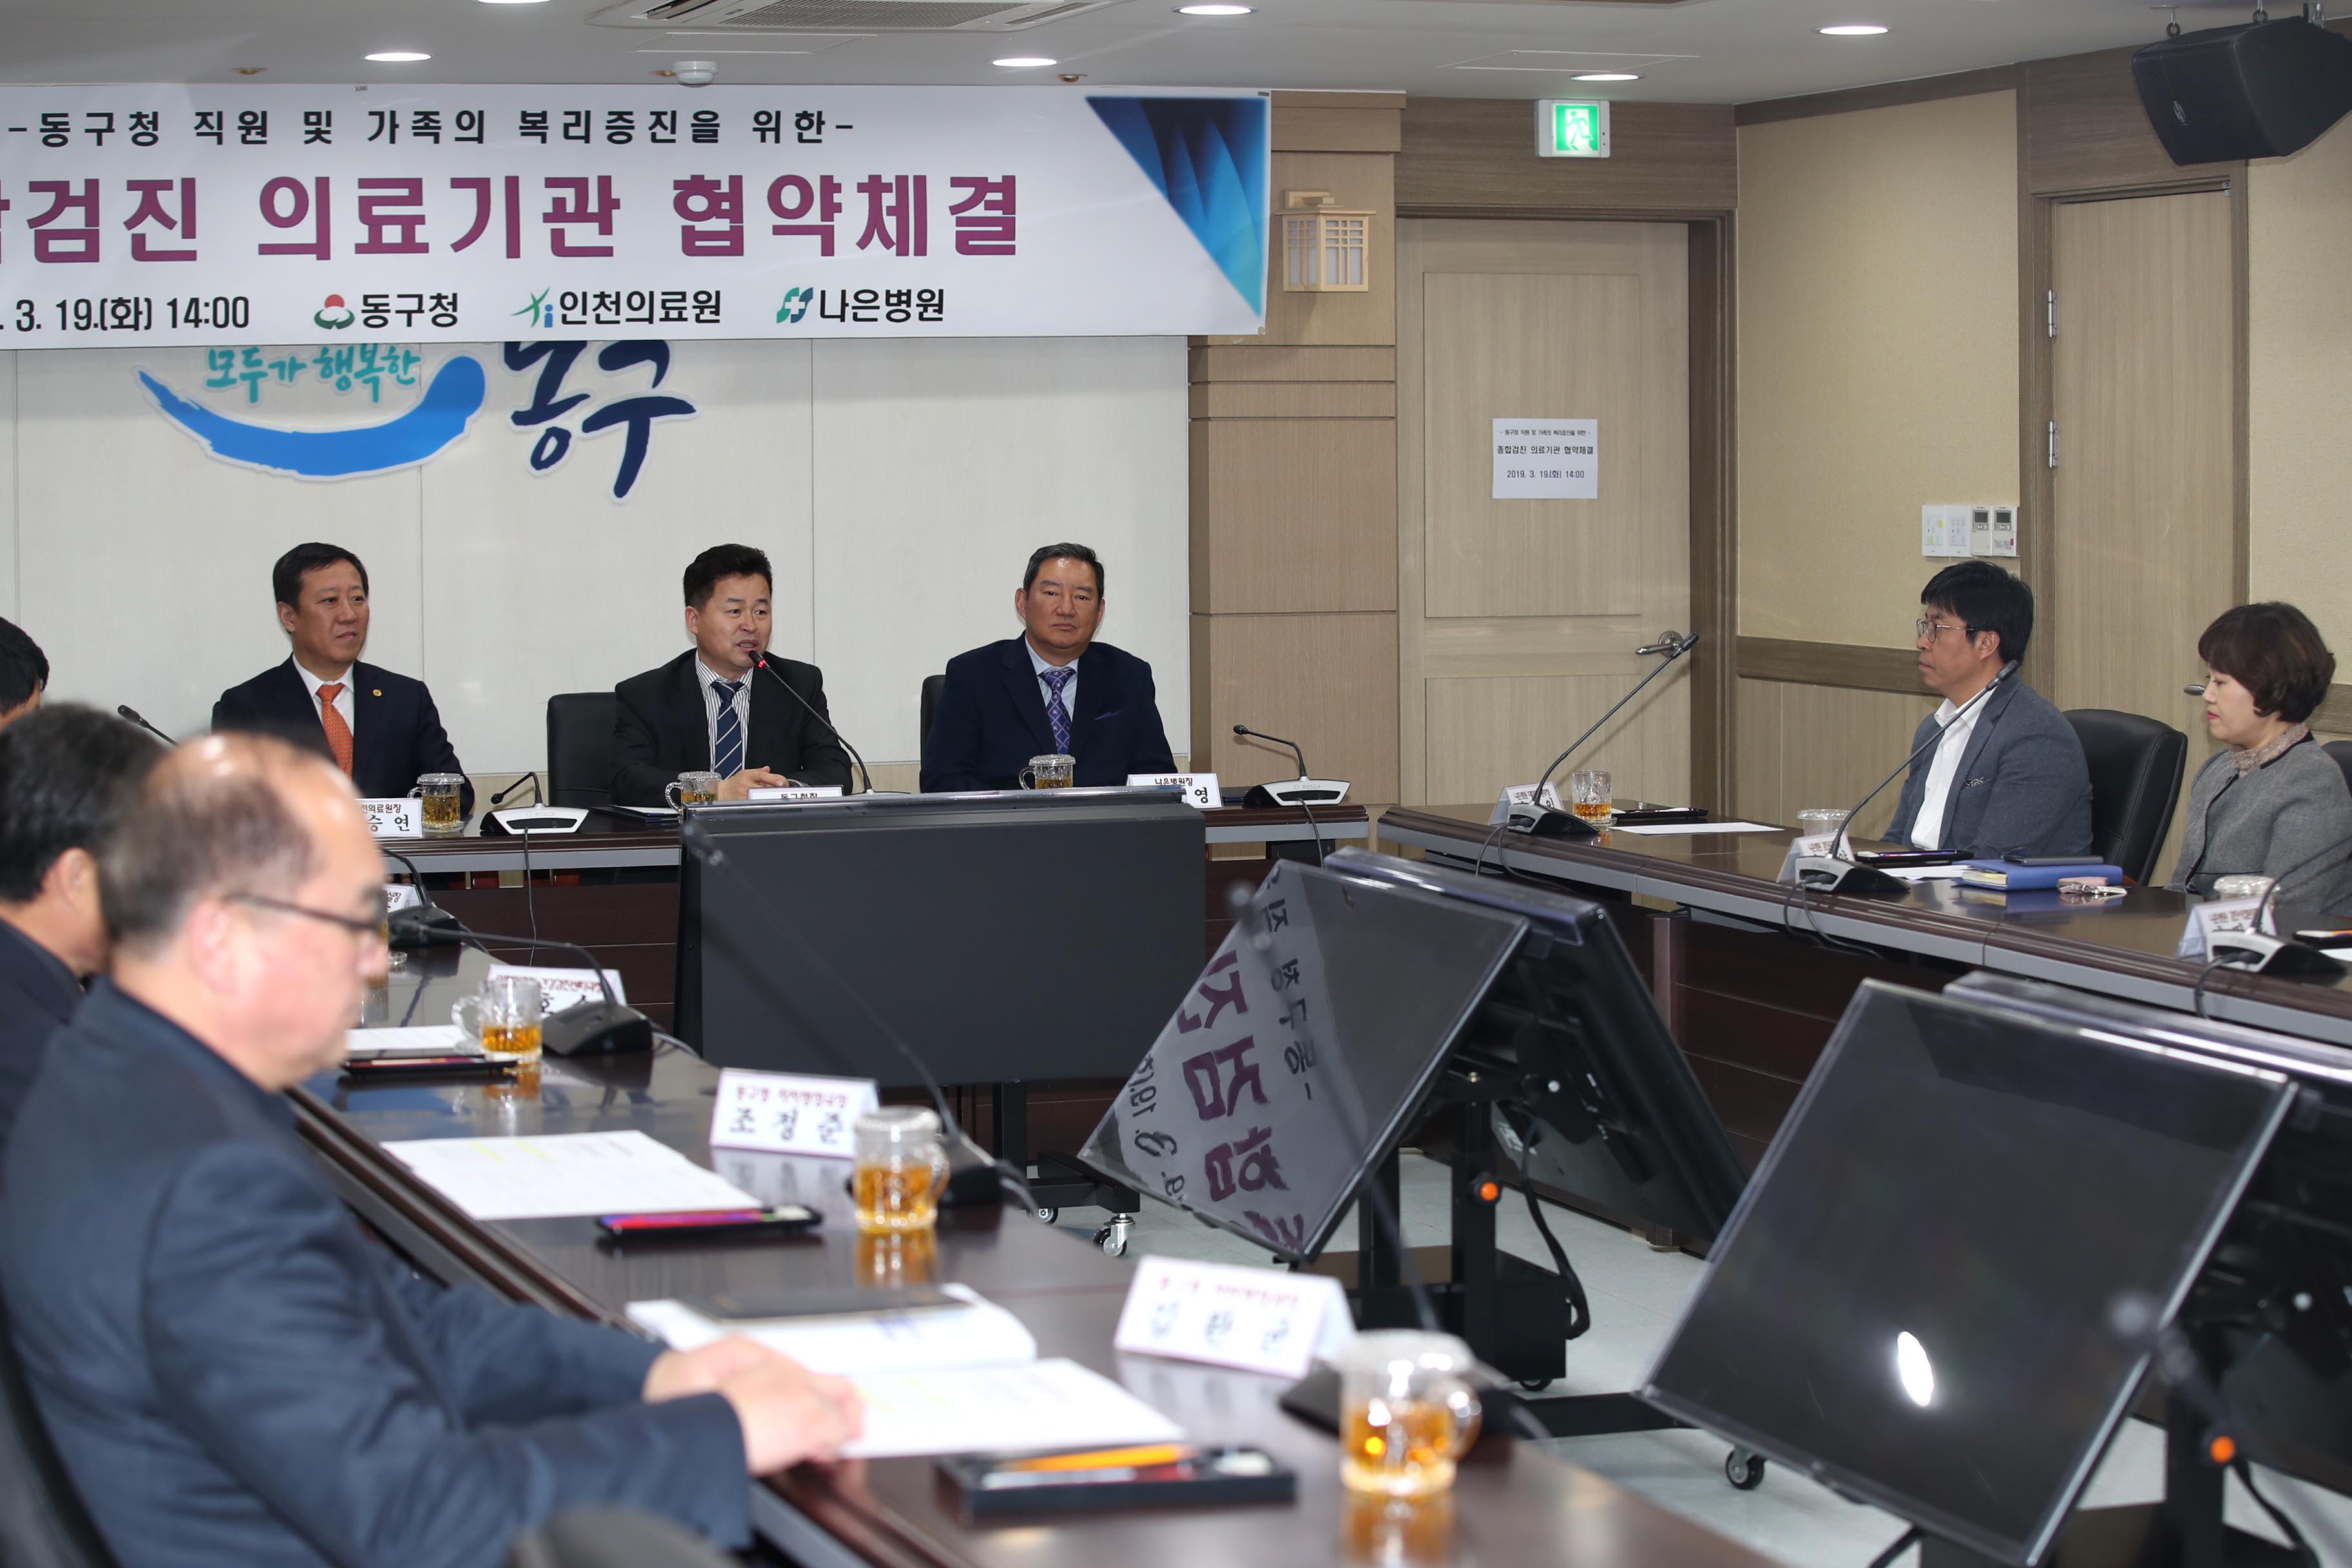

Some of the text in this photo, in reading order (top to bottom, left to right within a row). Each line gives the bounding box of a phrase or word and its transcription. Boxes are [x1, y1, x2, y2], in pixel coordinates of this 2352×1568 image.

[193, 110, 268, 146] 직원
[304, 110, 332, 145] 및
[368, 110, 485, 144] 가족의
[518, 110, 721, 145] 복리증진을
[0, 174, 1017, 264] 검진 의료기관 협약체결
[16, 296, 250, 331] 3. 19.(화) 14:00
[361, 293, 458, 328] 동구청
[560, 290, 721, 324] 인천의료원
[819, 289, 945, 323] 나은병원
[206, 344, 422, 404] 모두가 행복한
[504, 340, 697, 498] 동구
[1496, 446, 1593, 455] 종합검진 의료기관 협약체결
[1507, 470, 1585, 478] 2019. 3. 19.(화) 14:00
[1155, 778, 1193, 787] 나은병원장
[1195, 787, 1209, 803] 영
[360, 803, 402, 814] 천의료원장
